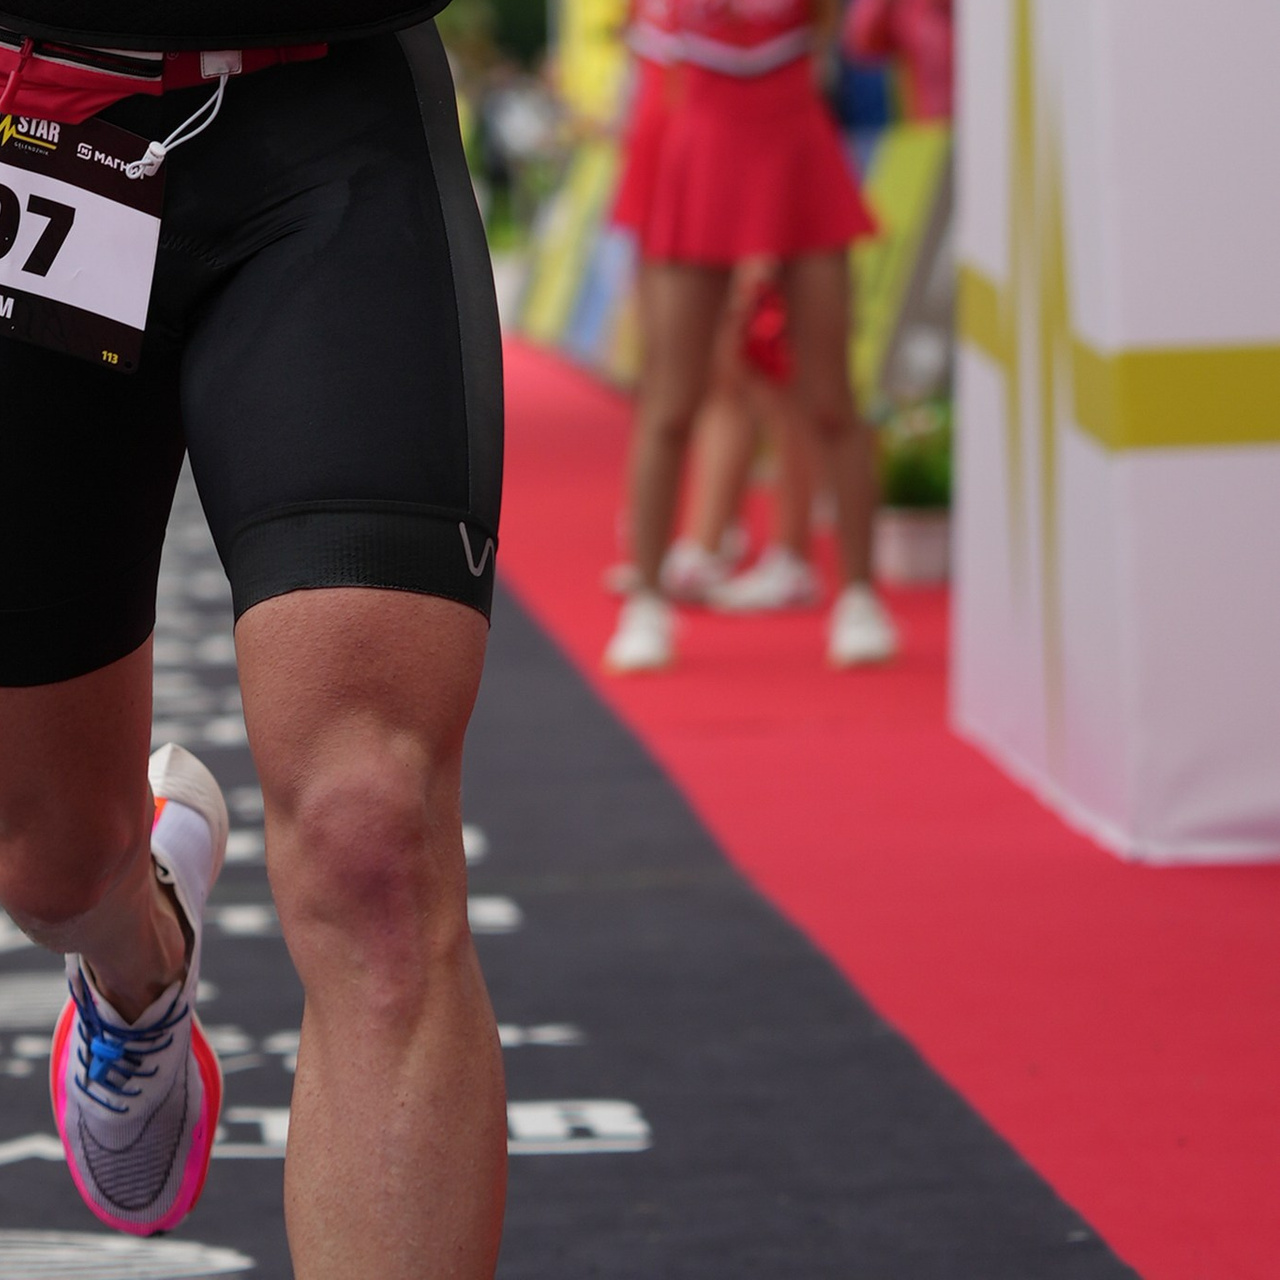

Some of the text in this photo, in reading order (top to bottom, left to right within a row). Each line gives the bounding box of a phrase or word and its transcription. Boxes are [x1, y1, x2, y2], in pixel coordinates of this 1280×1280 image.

[17, 115, 61, 144] STAR
[94, 150, 141, 176] МАГН
[101, 350, 119, 365] 113
[218, 1101, 647, 1144] TR
